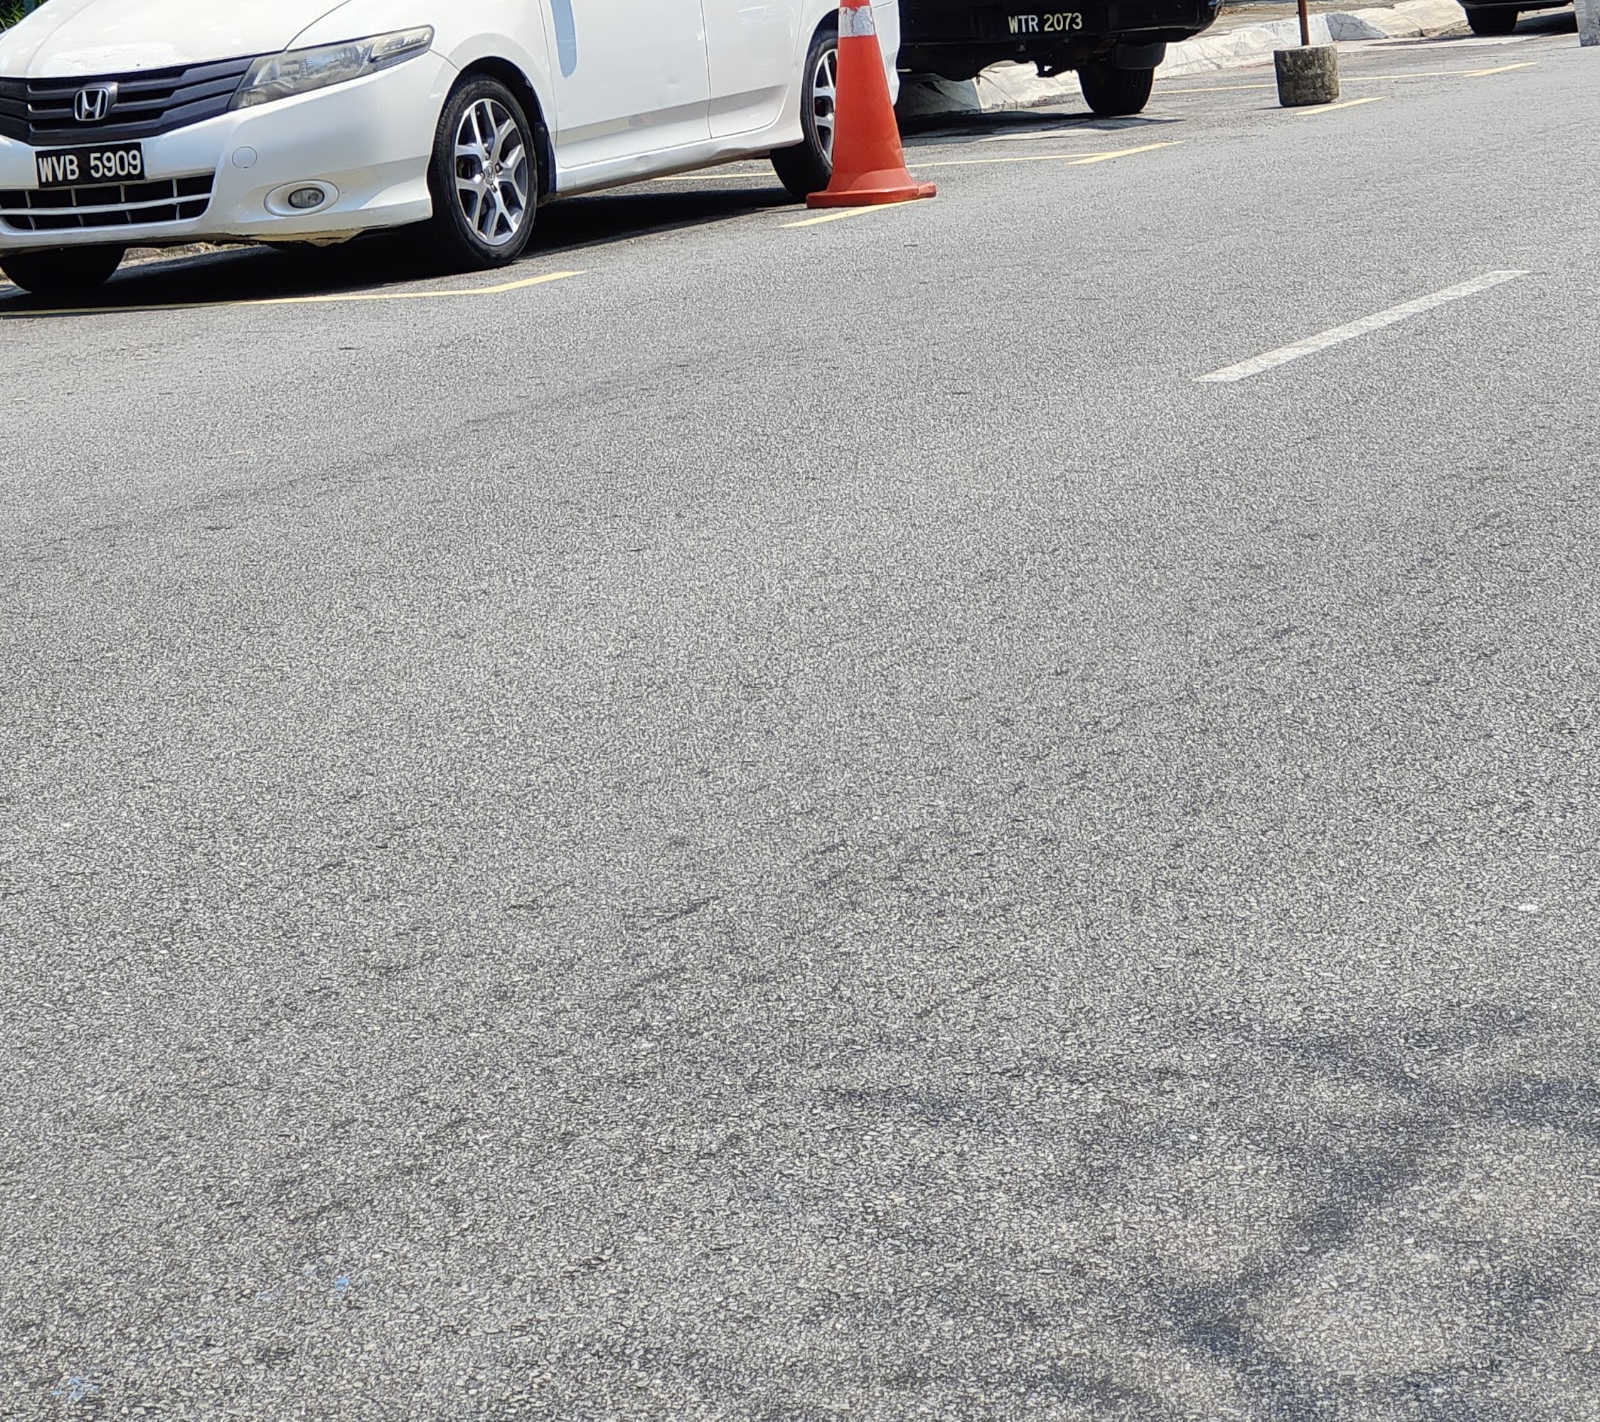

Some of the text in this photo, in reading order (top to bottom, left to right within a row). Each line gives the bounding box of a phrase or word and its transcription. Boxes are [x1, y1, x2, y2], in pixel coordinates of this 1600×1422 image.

[1008, 12, 1083, 34] WTR 2073
[38, 149, 142, 183] WVB 5909
